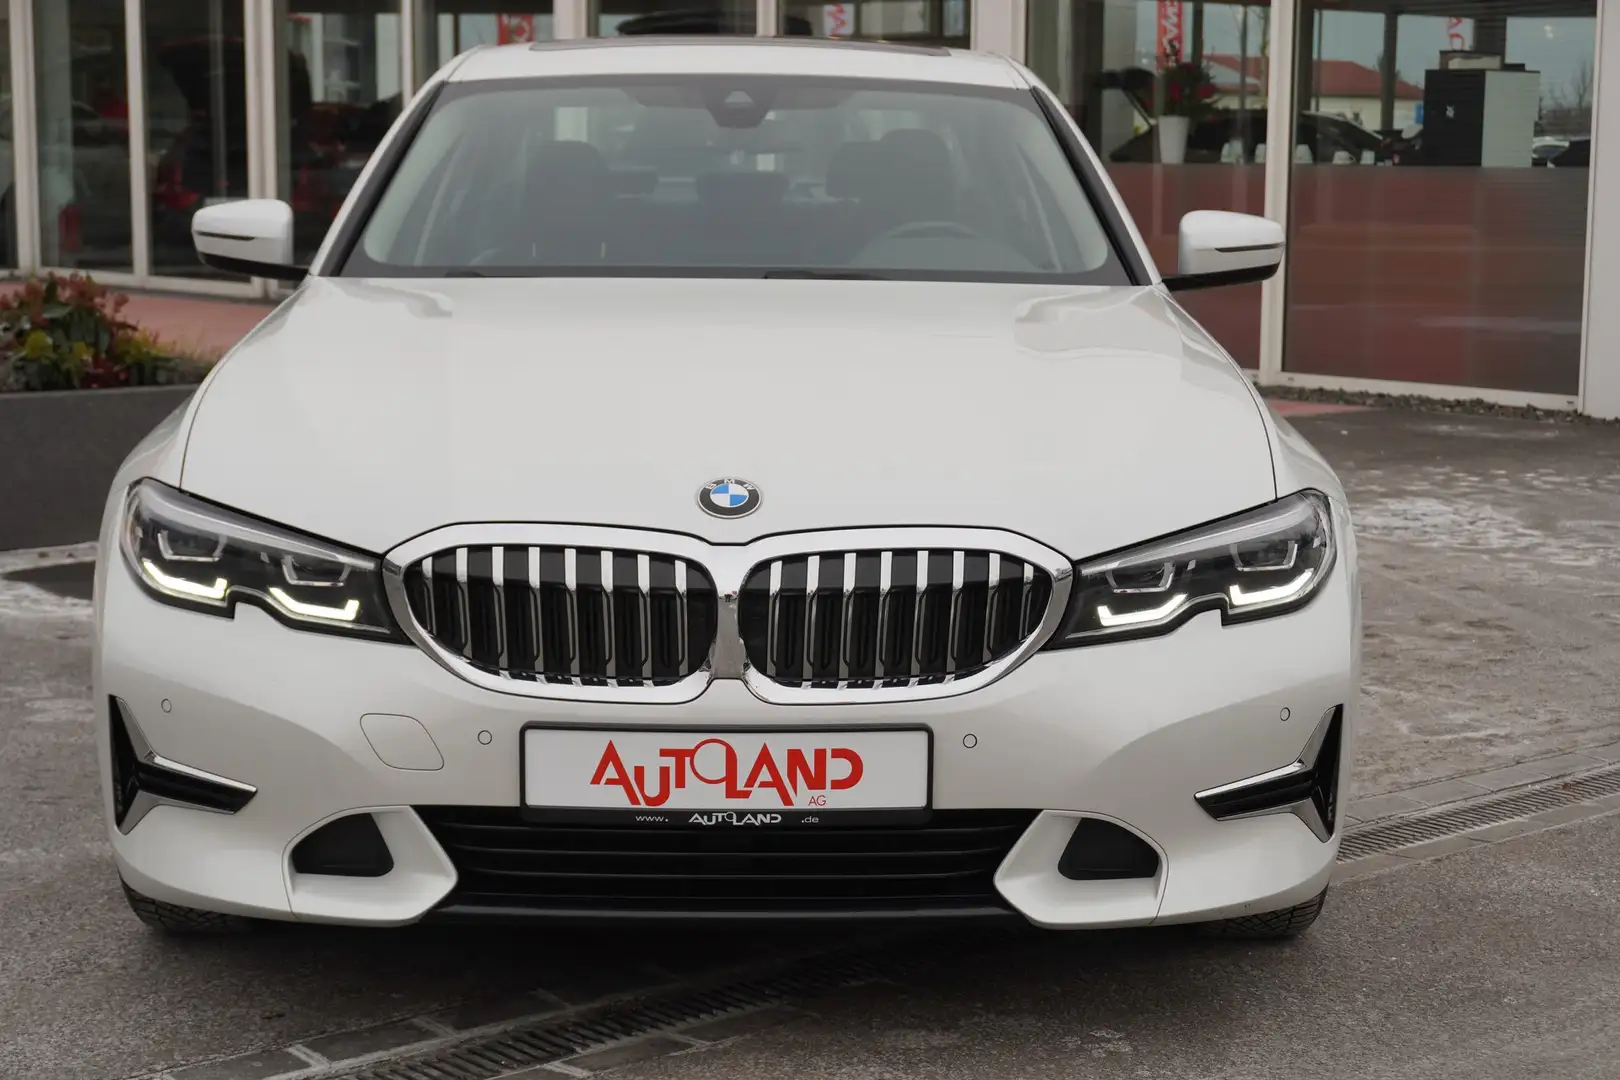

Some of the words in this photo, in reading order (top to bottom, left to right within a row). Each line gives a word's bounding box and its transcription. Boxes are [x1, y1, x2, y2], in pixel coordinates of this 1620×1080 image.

[704, 478, 757, 490] BMW
[589, 738, 864, 807] AUTOLAND
[808, 795, 827, 806] AG
[688, 811, 782, 826] AUTOLAND
[801, 815, 820, 824] .de
